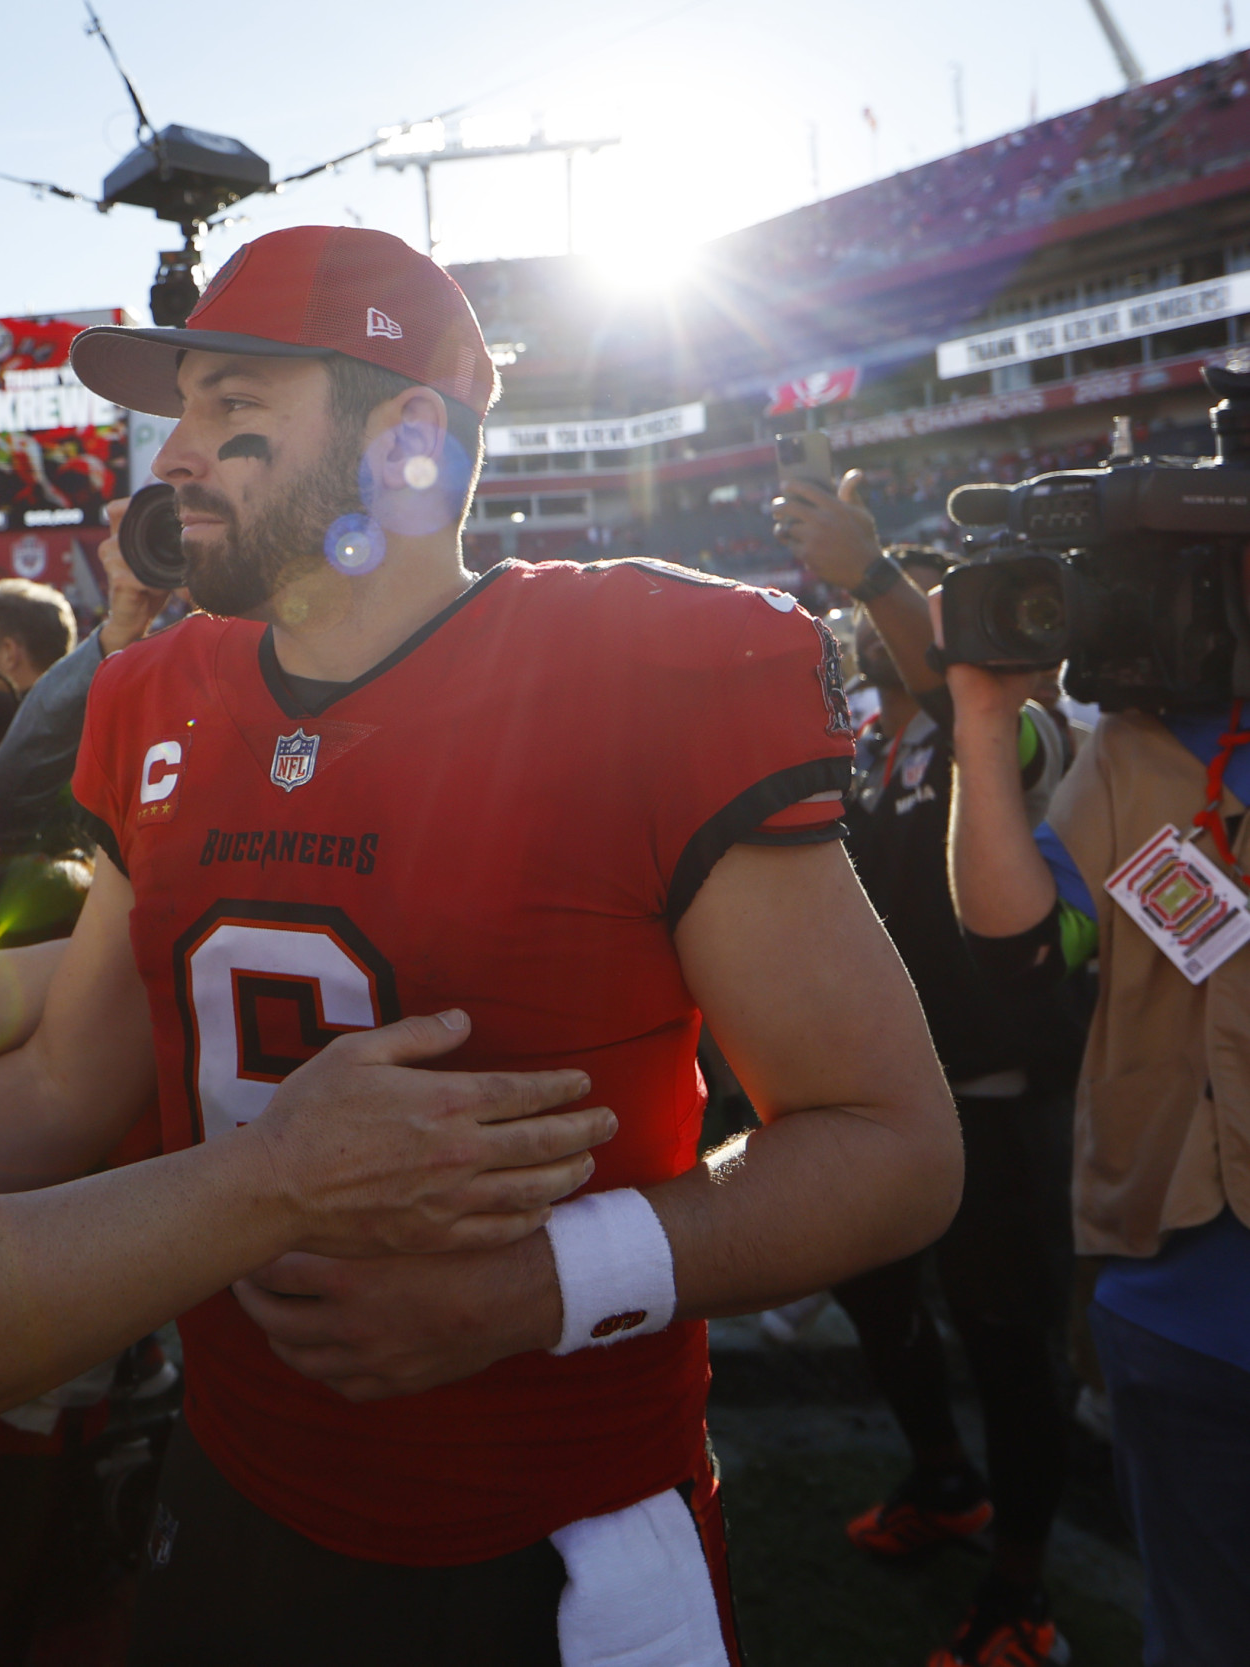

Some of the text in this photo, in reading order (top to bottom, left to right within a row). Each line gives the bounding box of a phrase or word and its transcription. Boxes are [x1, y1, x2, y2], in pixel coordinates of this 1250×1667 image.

[139, 740, 183, 805] C
[276, 755, 308, 781] NFL
[199, 828, 380, 876] BUCCANEERS
